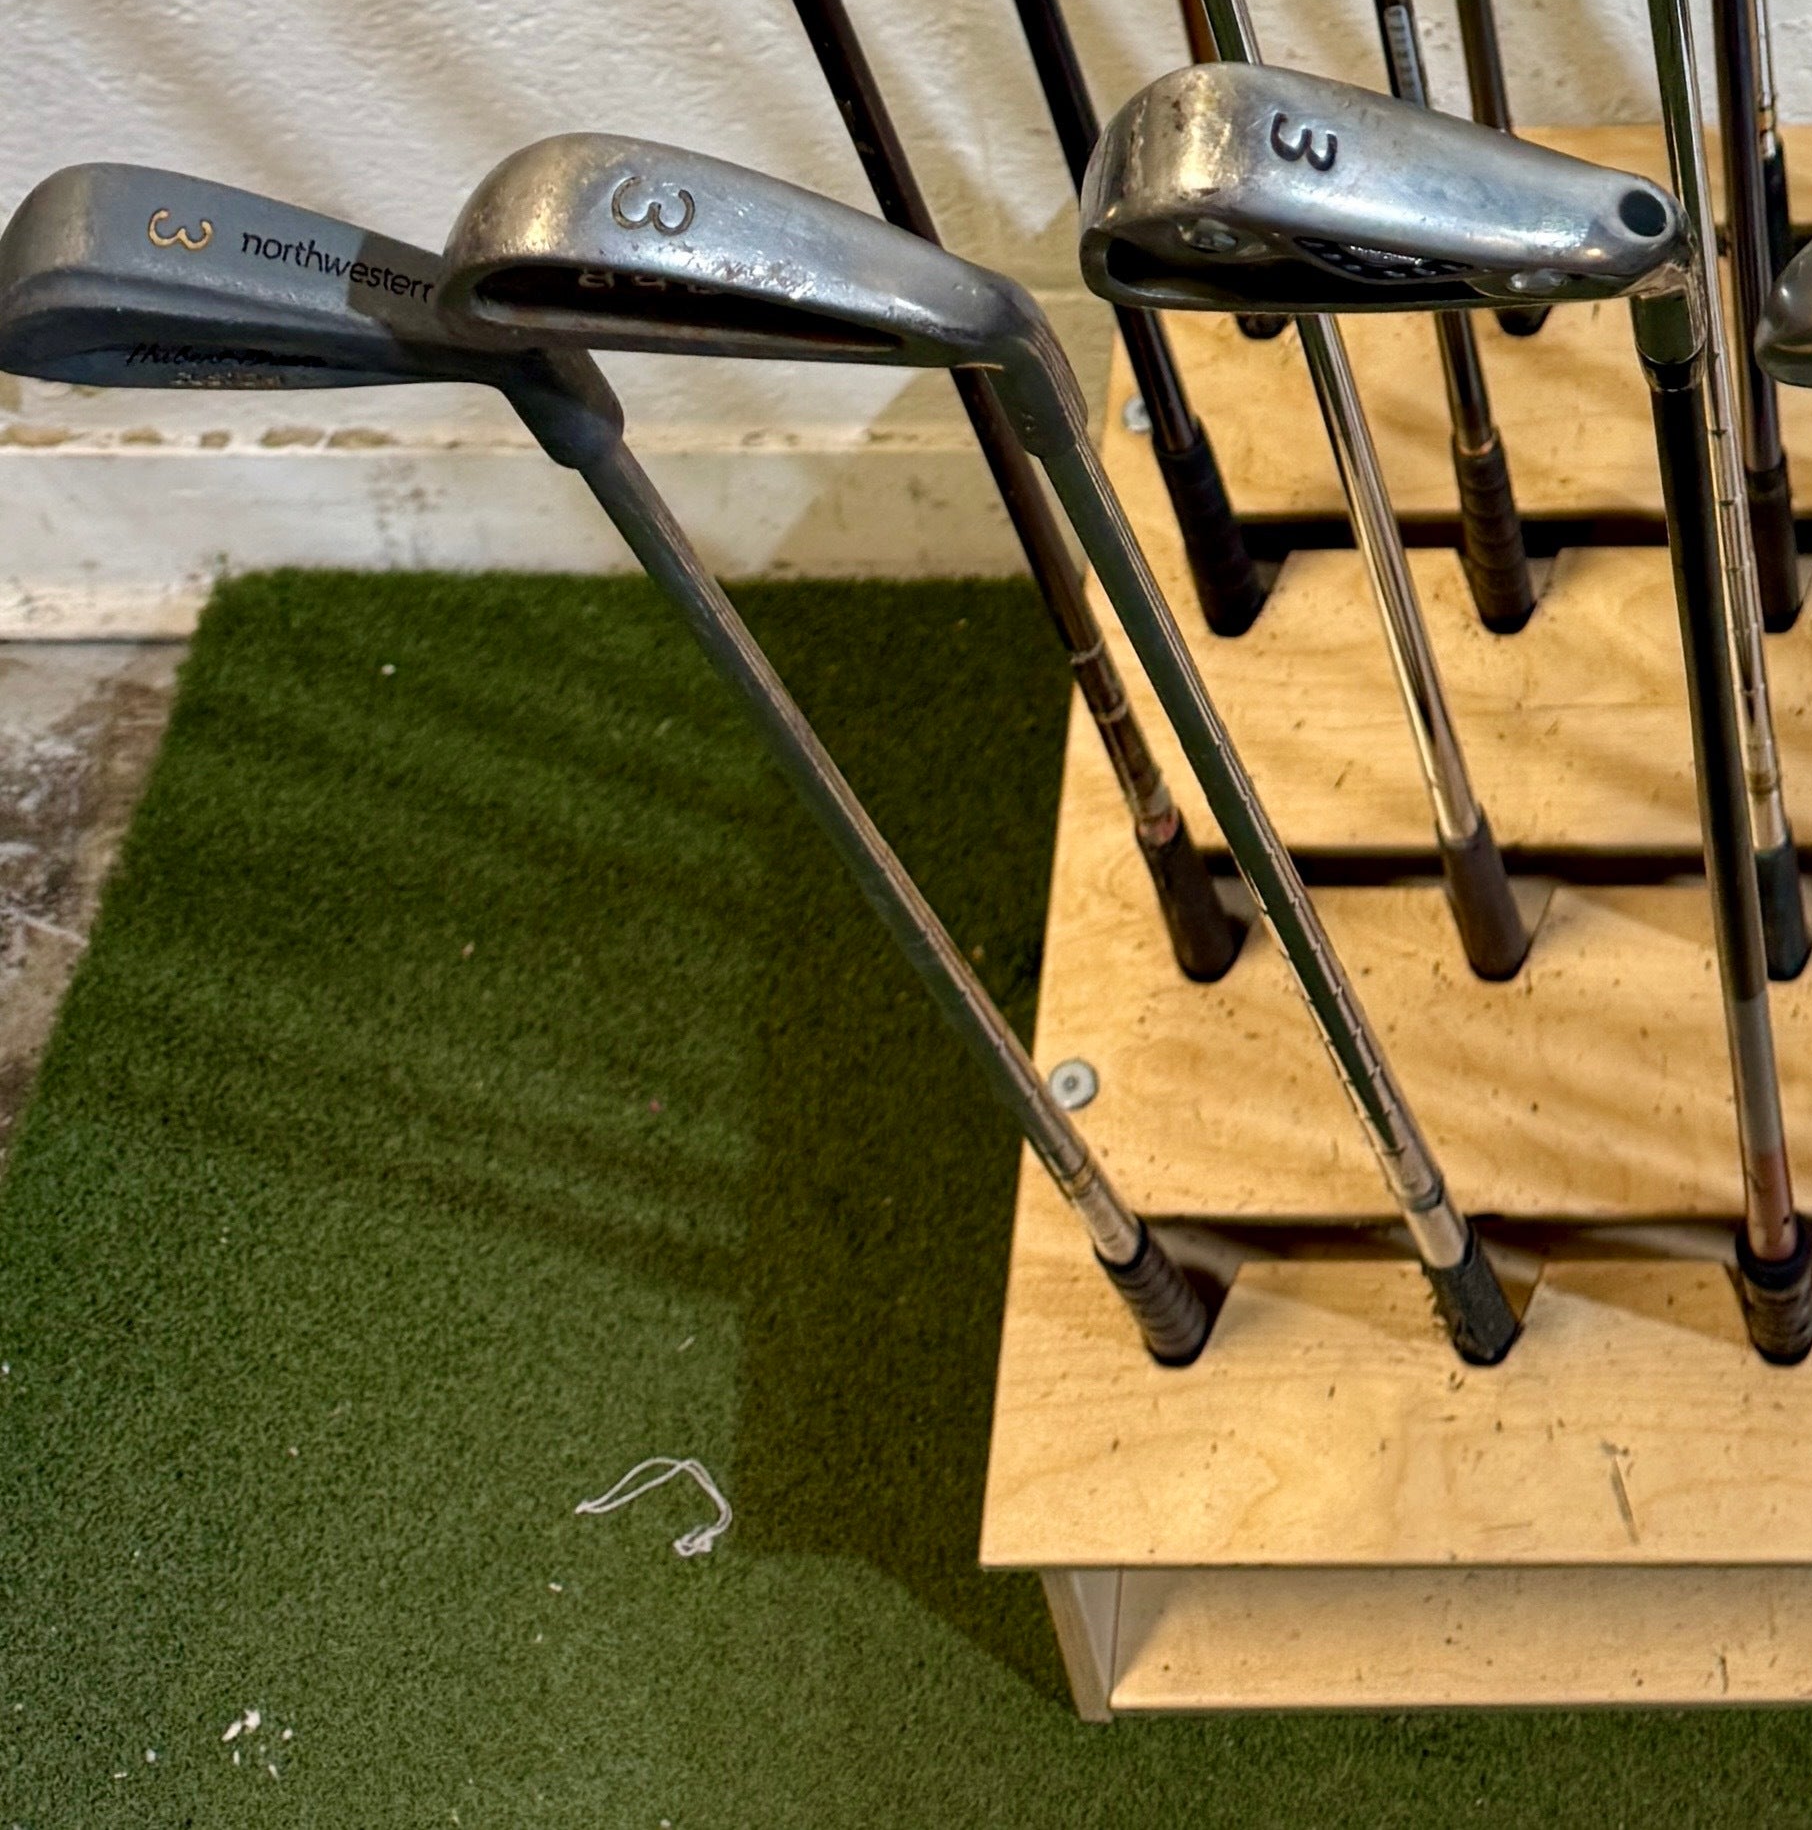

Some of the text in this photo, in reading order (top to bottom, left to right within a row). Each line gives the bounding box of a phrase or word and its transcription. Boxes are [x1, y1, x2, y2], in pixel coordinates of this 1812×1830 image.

[1271, 112, 1337, 171] 3
[147, 208, 213, 250] 3
[611, 175, 695, 236] 3
